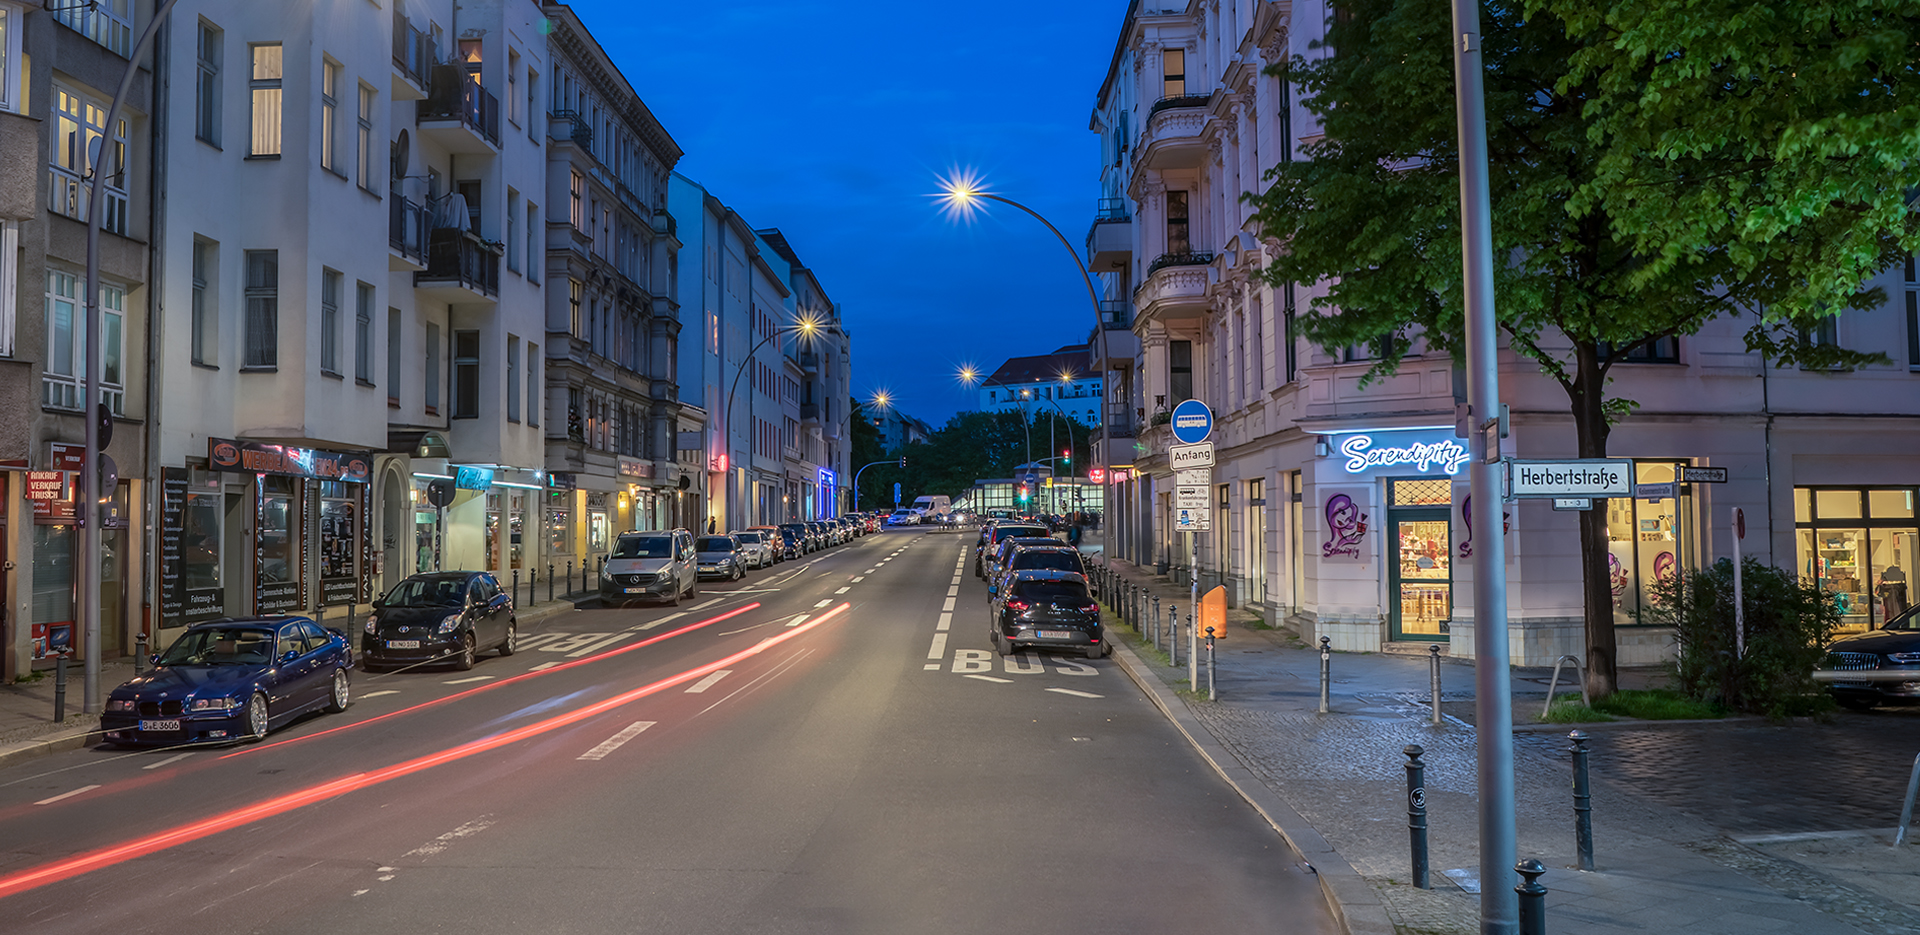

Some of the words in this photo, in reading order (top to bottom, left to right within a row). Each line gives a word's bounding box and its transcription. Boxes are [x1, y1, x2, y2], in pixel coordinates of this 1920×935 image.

[1174, 450, 1211, 461] Anfang
[1342, 436, 1470, 474] Serendipity
[31, 472, 58, 480] ANKAUF
[1521, 468, 1618, 489] Herbertstraße
[1685, 469, 1724, 480] Herbertstraße
[31, 482, 62, 490] VERKAUF
[31, 491, 58, 499] TAUSCH
[952, 649, 1099, 675] BUS
